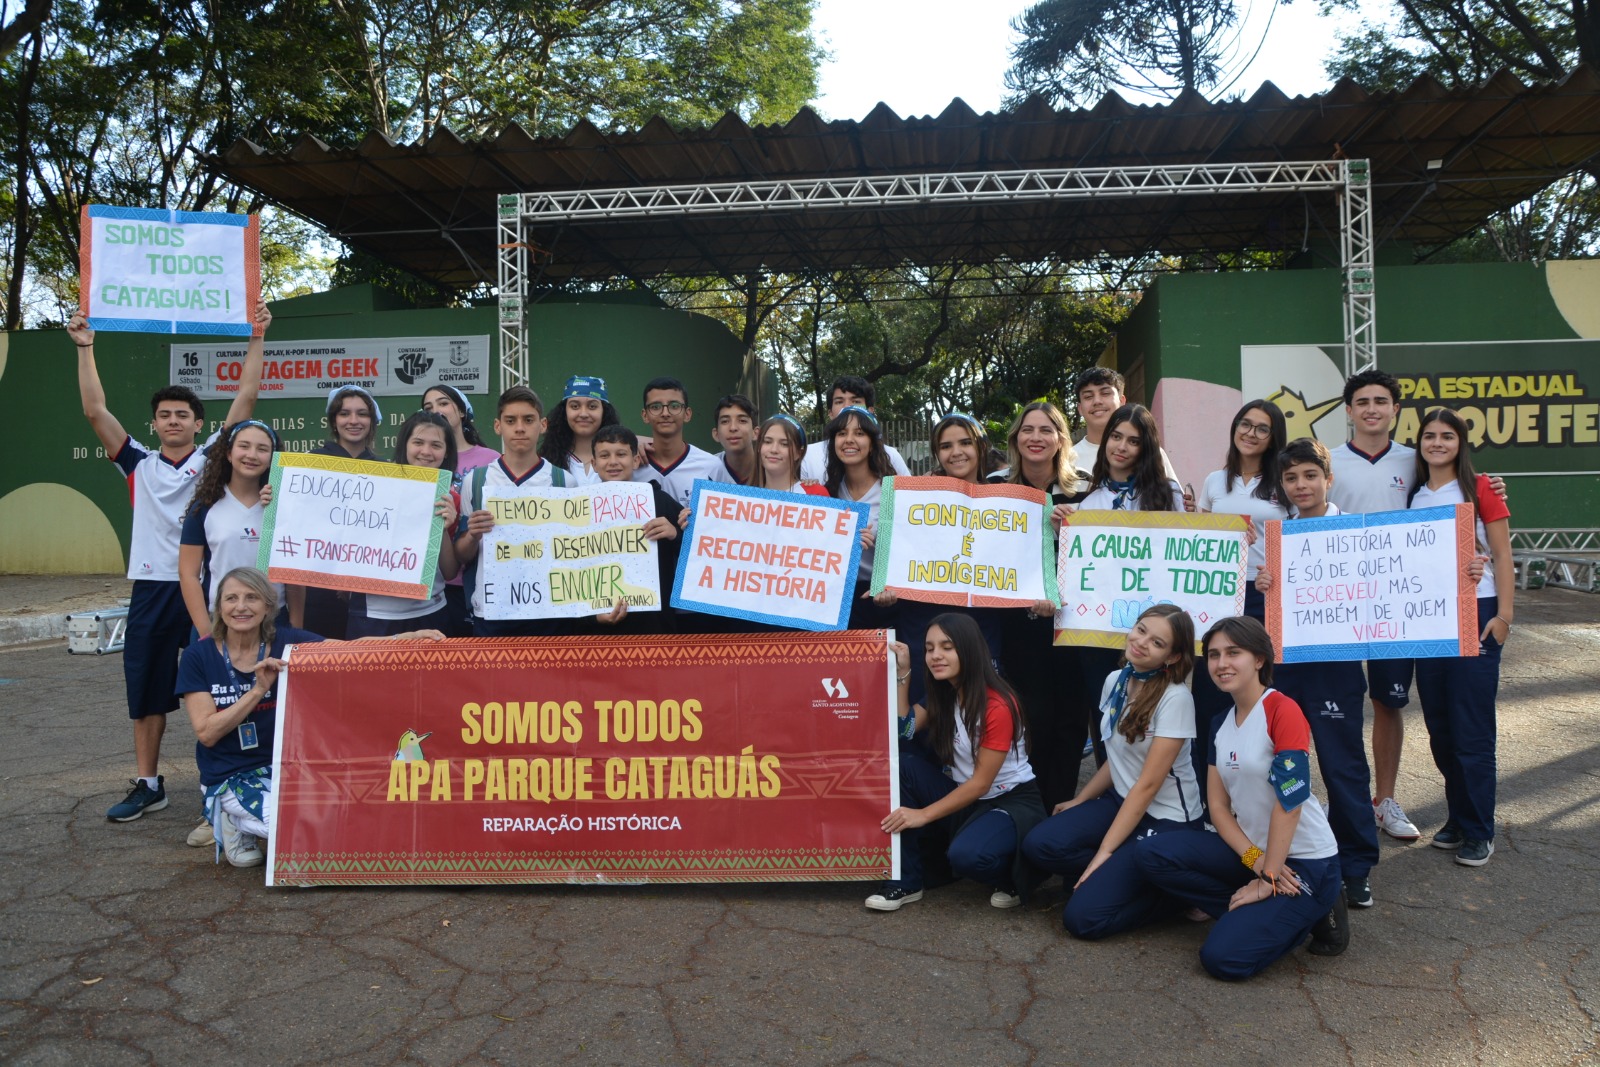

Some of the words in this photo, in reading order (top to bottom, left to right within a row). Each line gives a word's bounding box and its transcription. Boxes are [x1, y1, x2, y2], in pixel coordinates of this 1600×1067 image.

[105, 223, 185, 247] SOMOS
[146, 253, 224, 275] TODOS
[101, 281, 231, 313] CATAGUÁS!
[182, 351, 199, 367] 16
[216, 350, 242, 358] CULTURA
[305, 348, 310, 356] E
[330, 347, 346, 355] MAIS
[177, 368, 203, 376] AGOSTO
[179, 375, 201, 384] Sábado
[216, 360, 322, 381] COTAGEM
[327, 357, 379, 378] GEEK
[438, 373, 480, 381] CONTAGEM
[216, 383, 240, 392] PARQU
[268, 382, 284, 391] DIAS
[317, 381, 333, 389] COM
[362, 380, 375, 388] REY
[1439, 375, 1584, 399] ESTADUAL
[1547, 403, 1600, 443] FE
[289, 474, 375, 502] EDUCAÇÃO
[488, 499, 551, 520] TEMOS
[563, 498, 590, 518] QUE
[593, 494, 652, 523] PARAR
[703, 495, 828, 532] RENOMEAR
[833, 507, 852, 536] É
[907, 503, 1028, 534] CONTAGEM
[496, 544, 511, 560] DE
[523, 543, 544, 559] NOS
[553, 528, 648, 560] DESENVOLVER
[961, 531, 975, 557] É
[1068, 534, 1083, 558] A
[1091, 533, 1152, 560] CAUSA
[1164, 533, 1240, 563] INDÍGENA
[1300, 538, 1311, 558] A
[1326, 529, 1393, 554] HISTÓRIA
[1406, 524, 1436, 549] NÃO
[696, 535, 843, 576] RECONHECER
[1287, 561, 1298, 584] É
[1304, 558, 1323, 582] SÓ
[1329, 562, 1349, 579] DE
[1357, 554, 1404, 577] QUEM
[697, 565, 713, 589] A
[723, 568, 827, 604] HISTÓRIA
[907, 554, 1018, 591] INDÍGENA
[1080, 562, 1095, 591] É
[1121, 567, 1151, 592] DE
[1167, 568, 1237, 596] TODOS
[1389, 576, 1423, 595] MAS
[484, 583, 495, 604] E
[510, 581, 542, 605] NOS
[1292, 602, 1358, 627] TAMBÉM
[1404, 598, 1447, 621] QUEM
[210, 683, 228, 694] Eu
[460, 700, 584, 744] SOMOS
[594, 698, 704, 743] TODOS
[386, 759, 452, 802] APA
[463, 757, 594, 804] PARQUE
[604, 744, 781, 800] CATAGUÁS
[482, 814, 584, 834] REPARAÇÃO
[588, 813, 682, 832] HISTÓRICA
